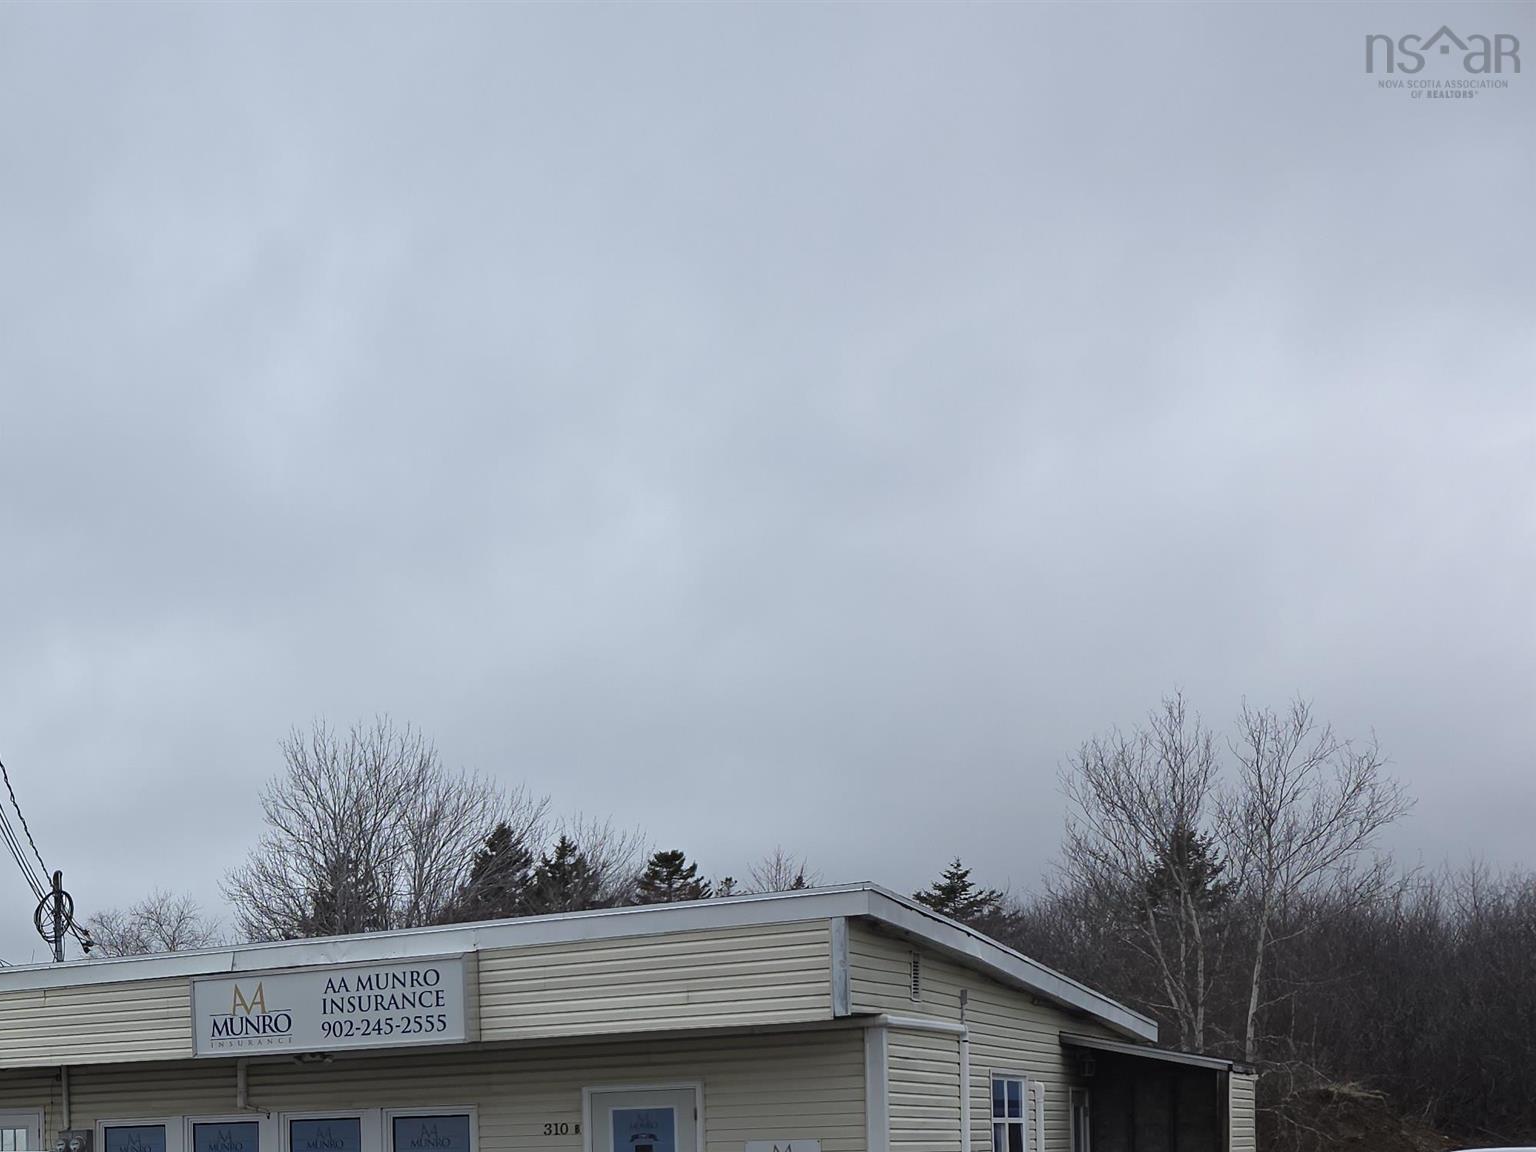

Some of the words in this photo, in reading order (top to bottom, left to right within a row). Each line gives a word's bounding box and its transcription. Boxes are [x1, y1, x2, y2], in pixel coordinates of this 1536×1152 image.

[324, 977, 350, 995] AA
[355, 968, 441, 992] MUNRO
[321, 989, 446, 1015] INSURANCE
[210, 1013, 293, 1038] MUNRO
[321, 1013, 447, 1039] 902-245-2555
[210, 1036, 293, 1049] INSURANCE
[543, 1122, 569, 1136] 310
